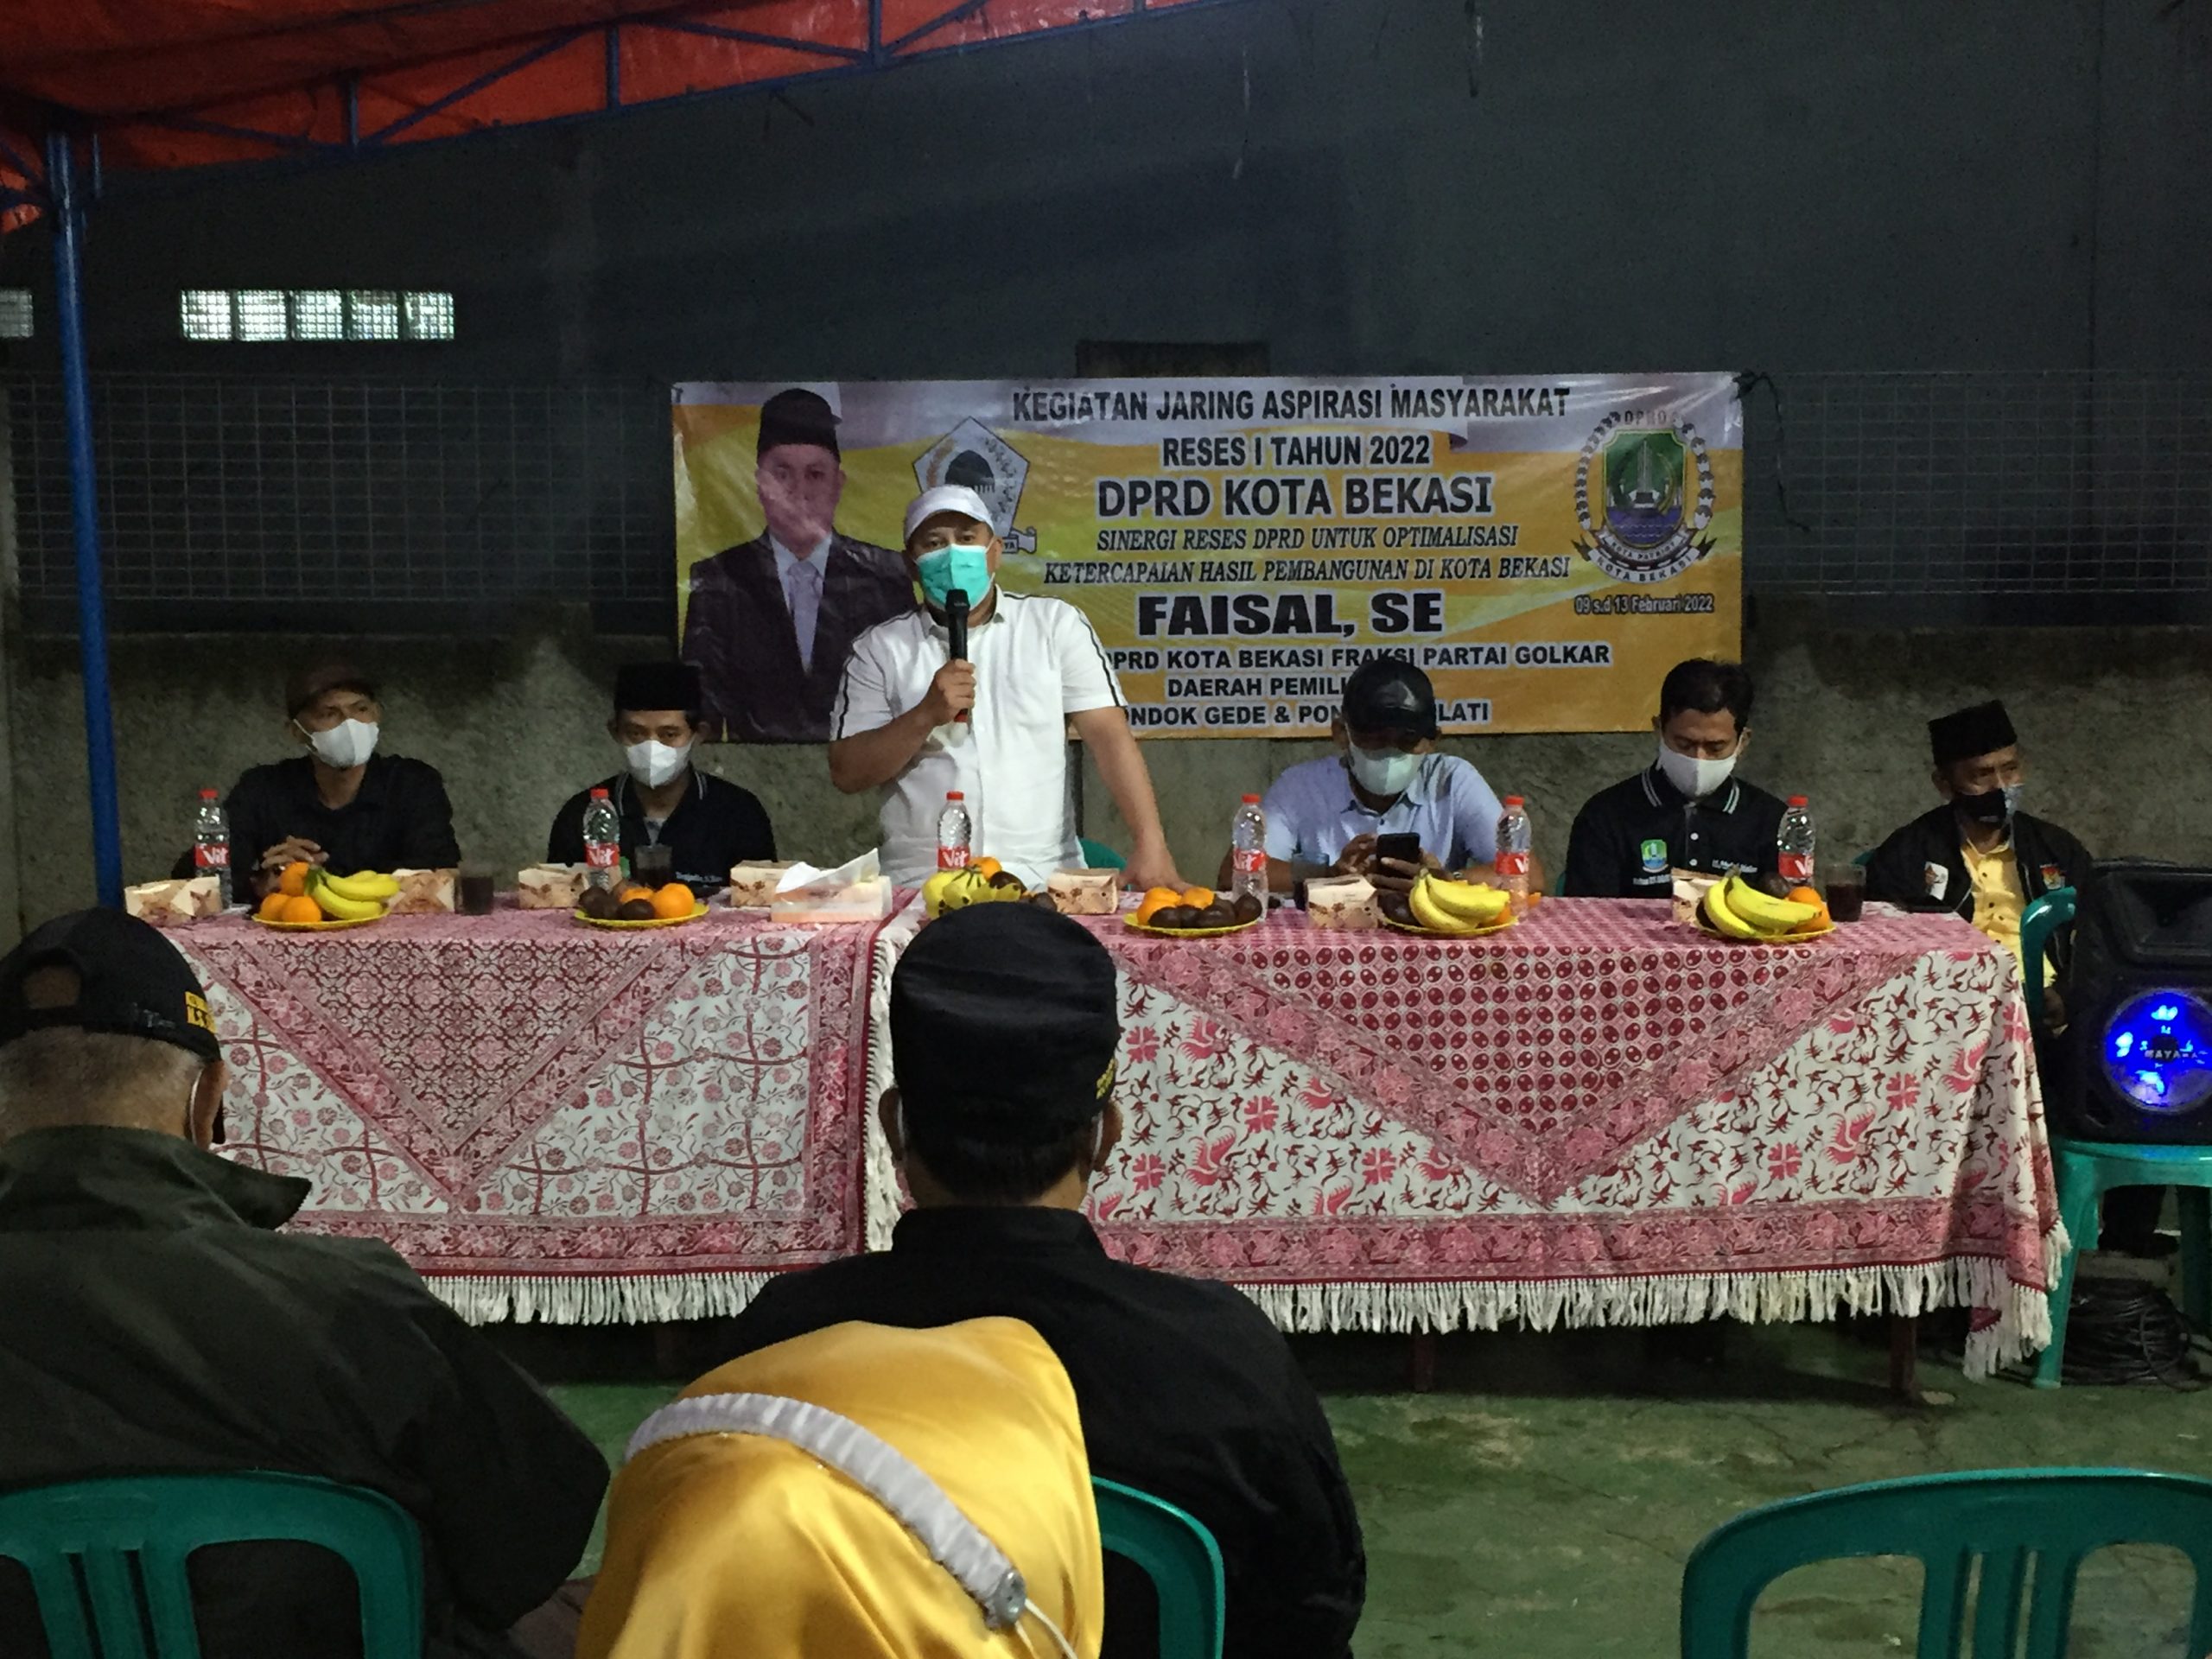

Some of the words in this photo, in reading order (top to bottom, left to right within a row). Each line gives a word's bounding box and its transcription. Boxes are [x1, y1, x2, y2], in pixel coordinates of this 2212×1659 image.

[1014, 391, 1147, 421] KEGIATAN
[1156, 391, 1253, 420] JARING
[1262, 390, 1382, 419] ASPIRASI
[1390, 387, 1570, 418] MASYARAKAT
[1163, 438, 1245, 467] RESES
[1255, 437, 1262, 466] I
[1271, 436, 1361, 465] TAHUN
[1370, 435, 1430, 465] 2022
[1099, 480, 1210, 517] DPRD
[1225, 479, 1332, 516] KOTA
[1346, 476, 1492, 514] BEKASI
[1097, 529, 1177, 550] SINERGI
[1182, 528, 1248, 550] RESES
[1253, 528, 1305, 550] DPRD
[1311, 526, 1378, 549] UNTUK
[1383, 525, 1519, 548] OPTIMALISASI
[1044, 562, 1196, 584] KETERCAPAIAN
[1198, 561, 1257, 582] HASIL
[1262, 559, 1412, 582] PEMBANGUNAN
[1414, 558, 1434, 580] DI
[1439, 557, 1491, 579] KOTA
[1497, 556, 1572, 579] BEKASI
[1598, 556, 1630, 581] KOTA
[1639, 555, 1692, 582] BEKASI
[1139, 594, 1355, 637] FAISAL,
[1371, 592, 1442, 634] SE
[1575, 596, 1590, 614] 09
[1614, 595, 1629, 614] 13
[1685, 594, 1713, 613] 2022
[1107, 651, 1159, 670] PRD
[1167, 650, 1231, 669] KOTA
[1238, 649, 1323, 668] BEKASI
[1424, 646, 1506, 665] PARTAI
[1516, 645, 1610, 664] GOLKAR
[1168, 677, 1262, 697] DAERAH
[1125, 705, 1197, 726] NDOK
[1205, 705, 1266, 725] GEDE
[1274, 706, 1290, 724] &
[1434, 703, 1488, 722] LATI
[942, 850, 969, 868] Vit
